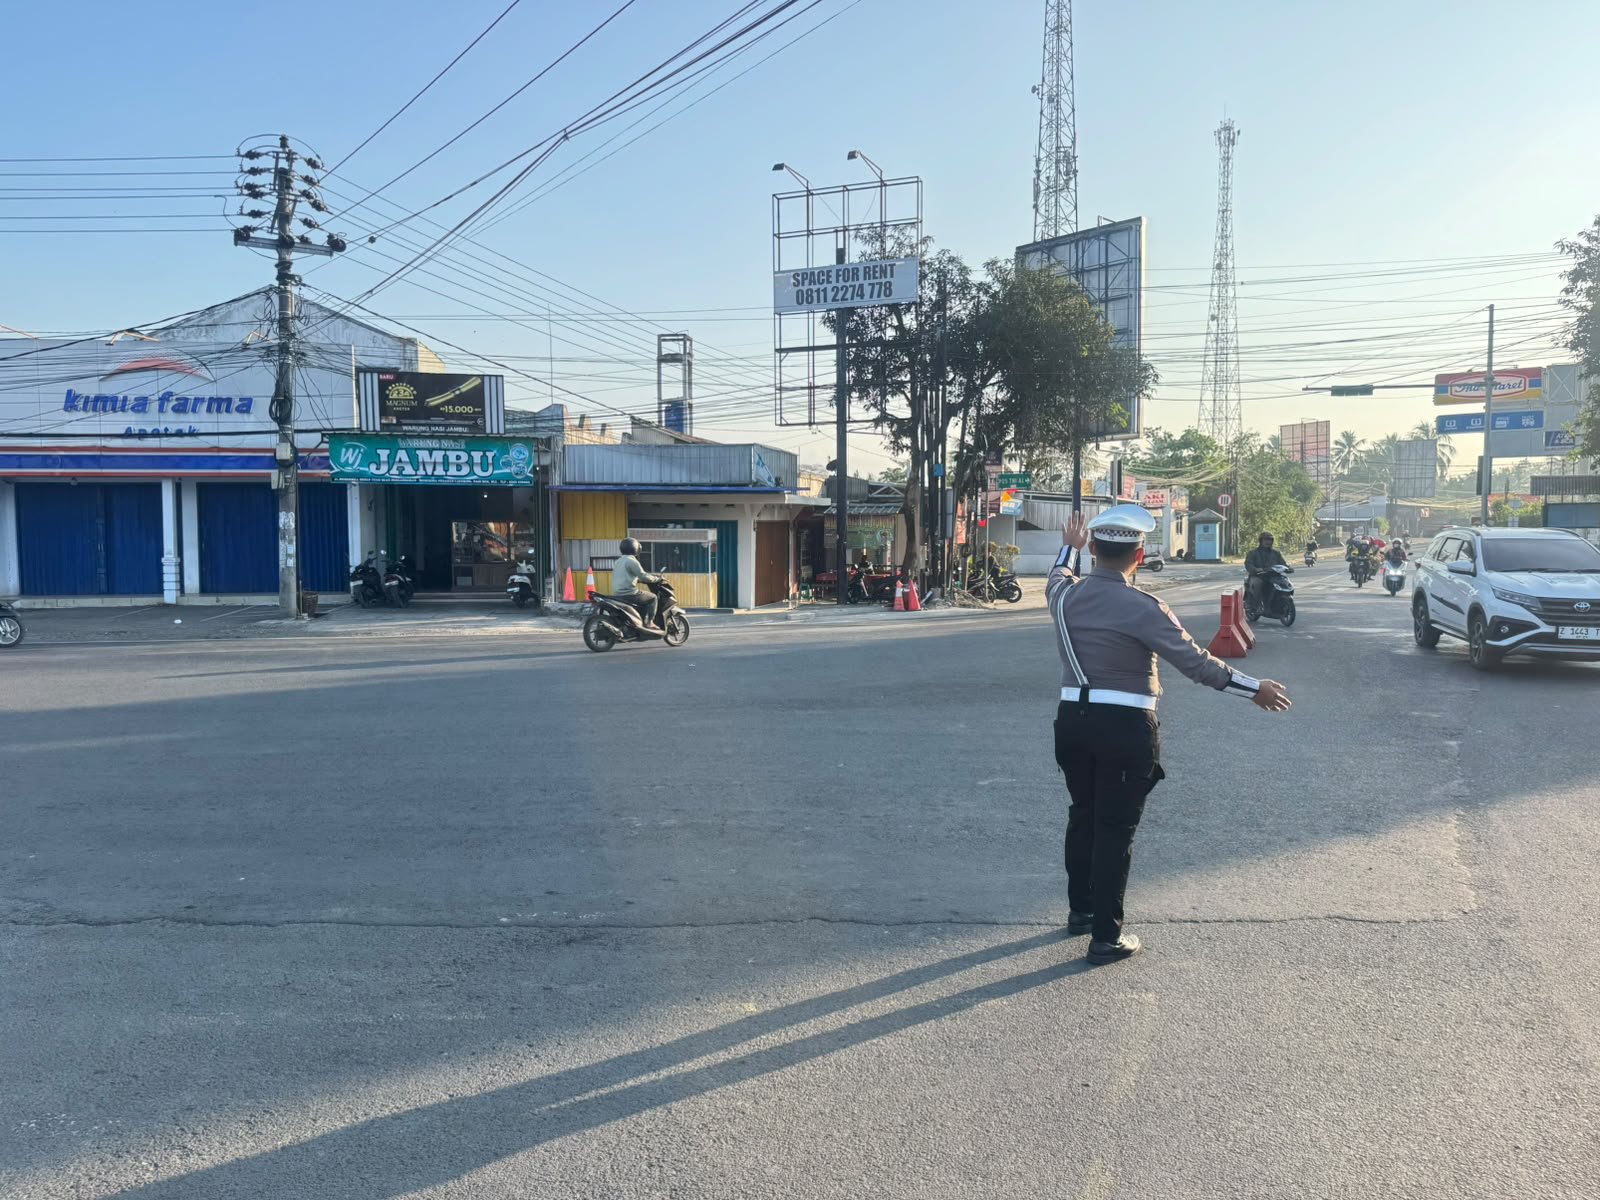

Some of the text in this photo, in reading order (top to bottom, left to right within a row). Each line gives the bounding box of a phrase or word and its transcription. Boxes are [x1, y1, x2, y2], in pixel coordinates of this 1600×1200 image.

[793, 263, 896, 287] SPACE FOR RENT
[796, 281, 892, 305] 0811 2274 778
[64, 389, 253, 413] kimia farma
[398, 438, 440, 449] WARUNG
[369, 448, 496, 478] JAMBU
